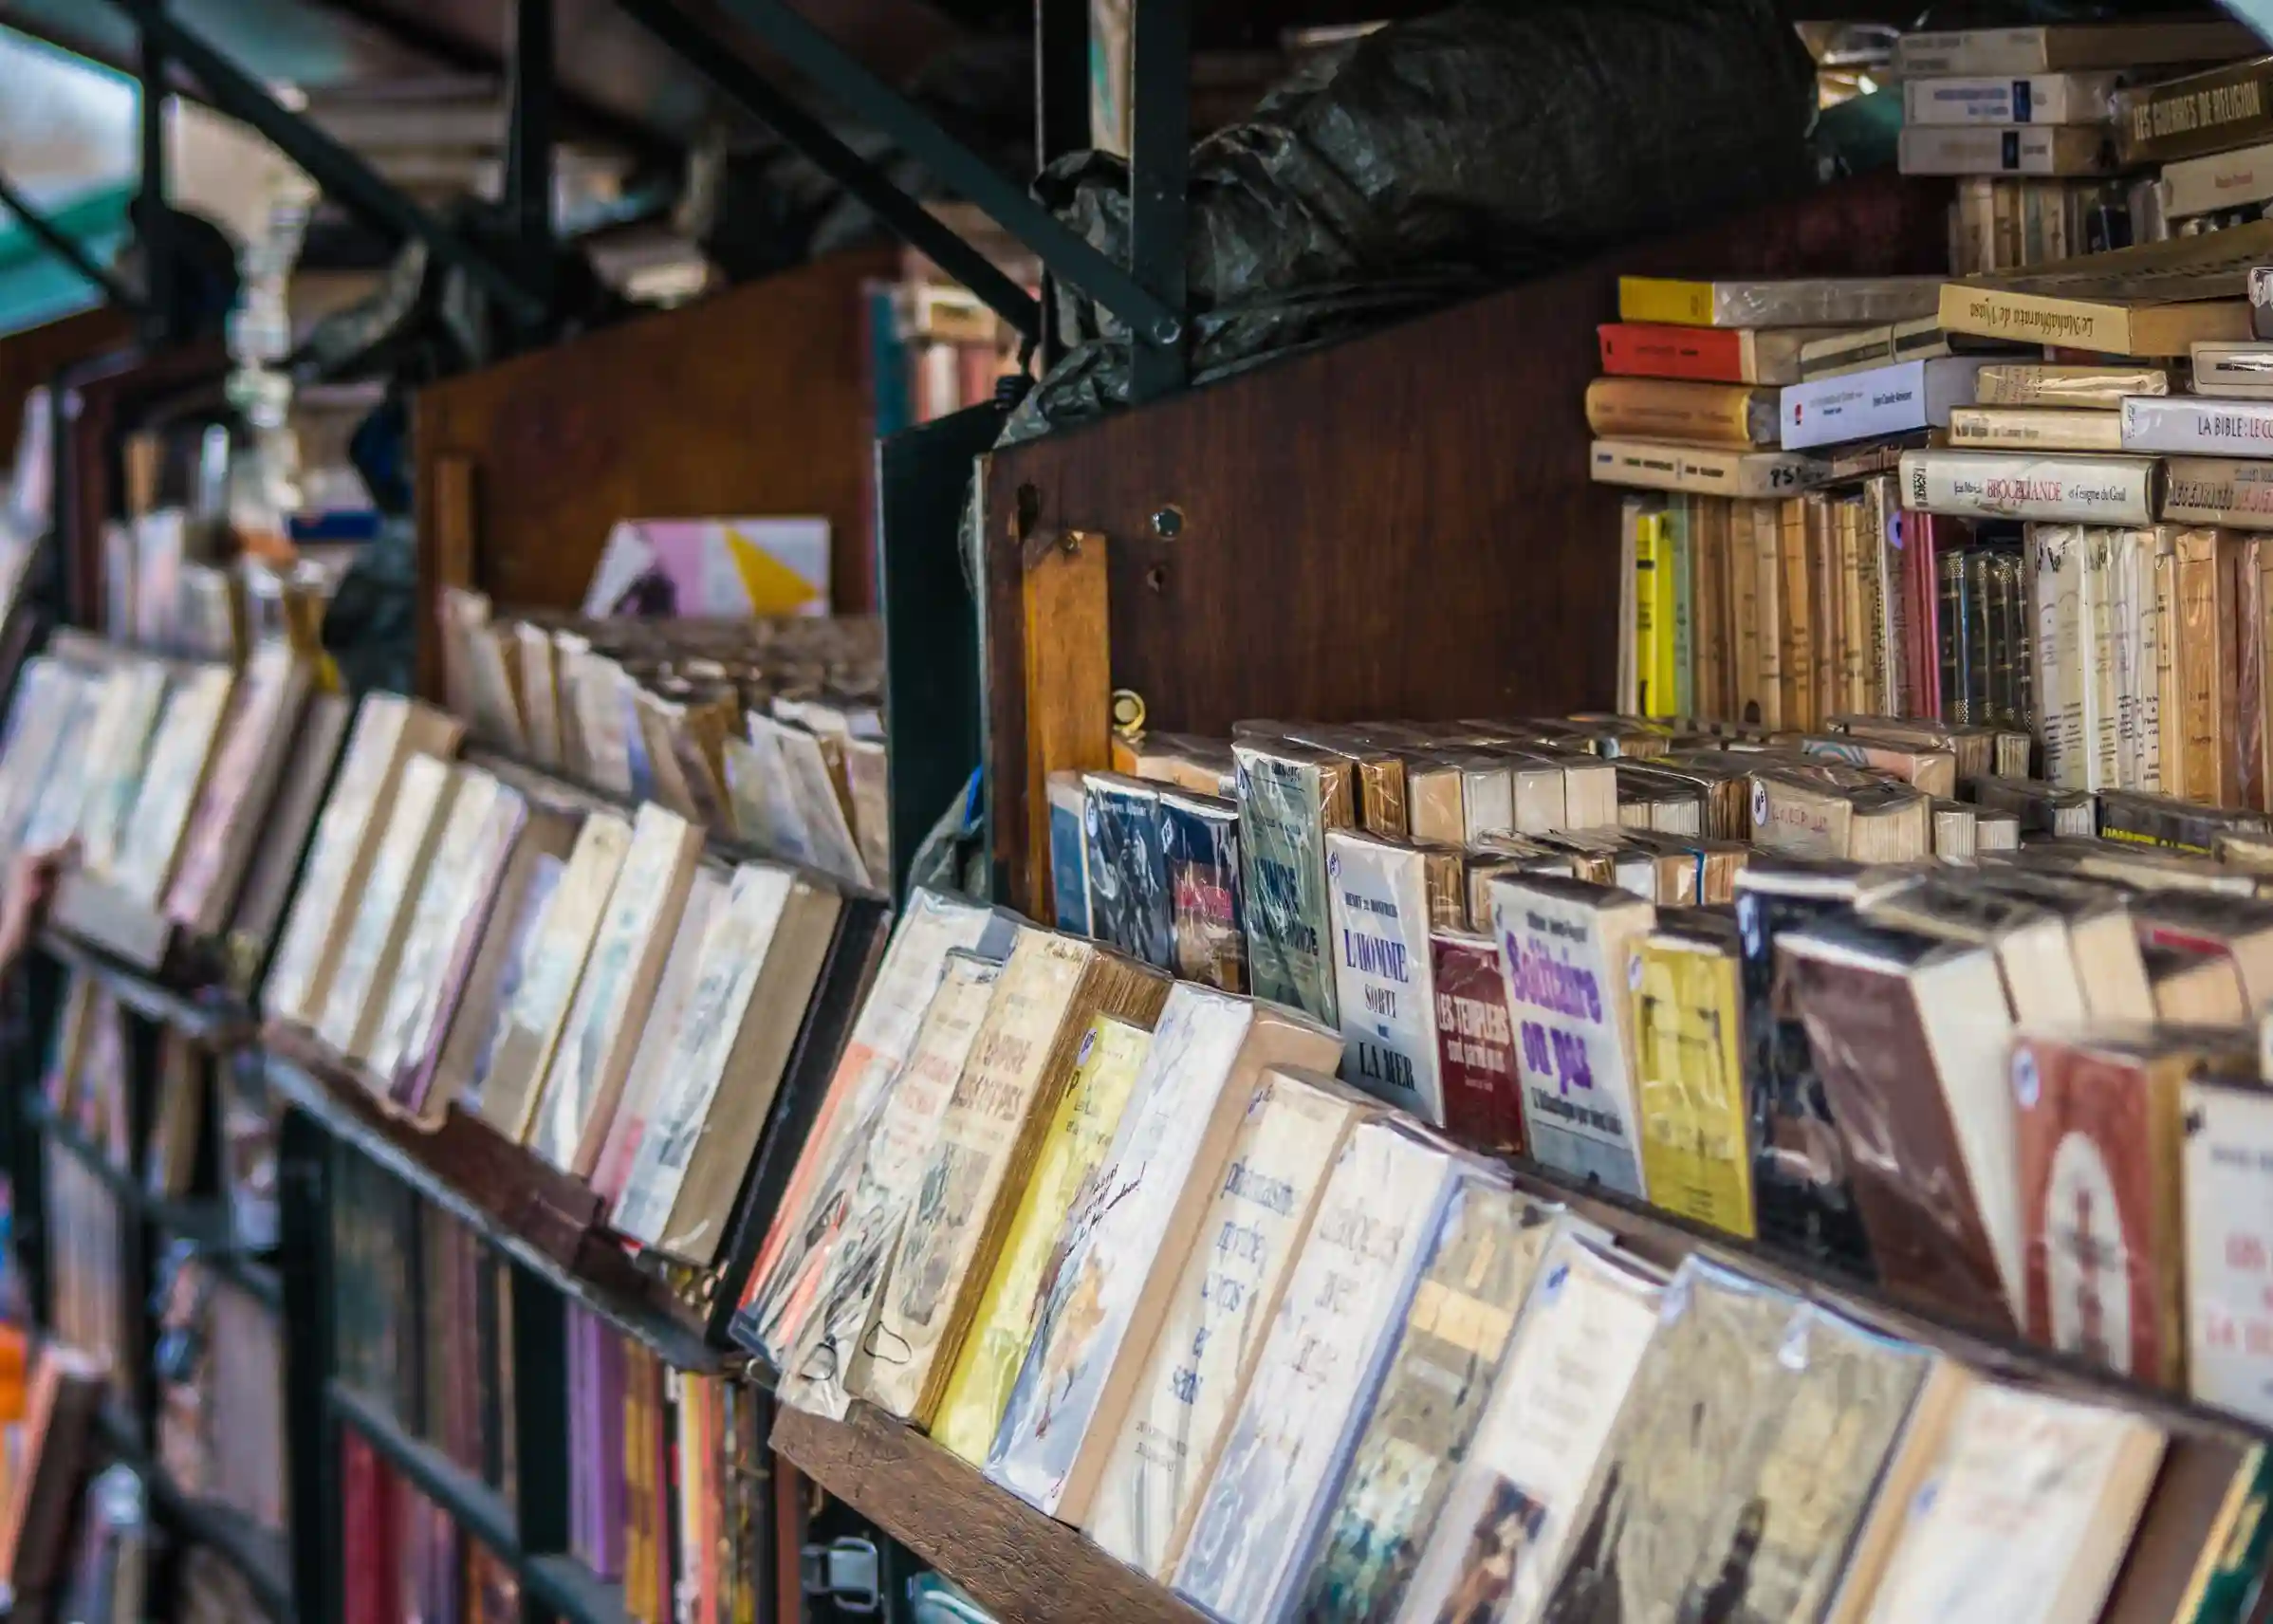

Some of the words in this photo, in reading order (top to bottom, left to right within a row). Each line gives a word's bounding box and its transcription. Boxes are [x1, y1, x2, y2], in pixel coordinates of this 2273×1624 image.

[2197, 415, 2212, 436] LA
[2249, 417, 2260, 438] LE
[1342, 928, 1409, 984] L'HOMME
[1363, 983, 1396, 1020] SORTI
[1435, 990, 1455, 1033] LES
[1358, 1041, 1382, 1080] LA
[1382, 1047, 1416, 1092] MER
